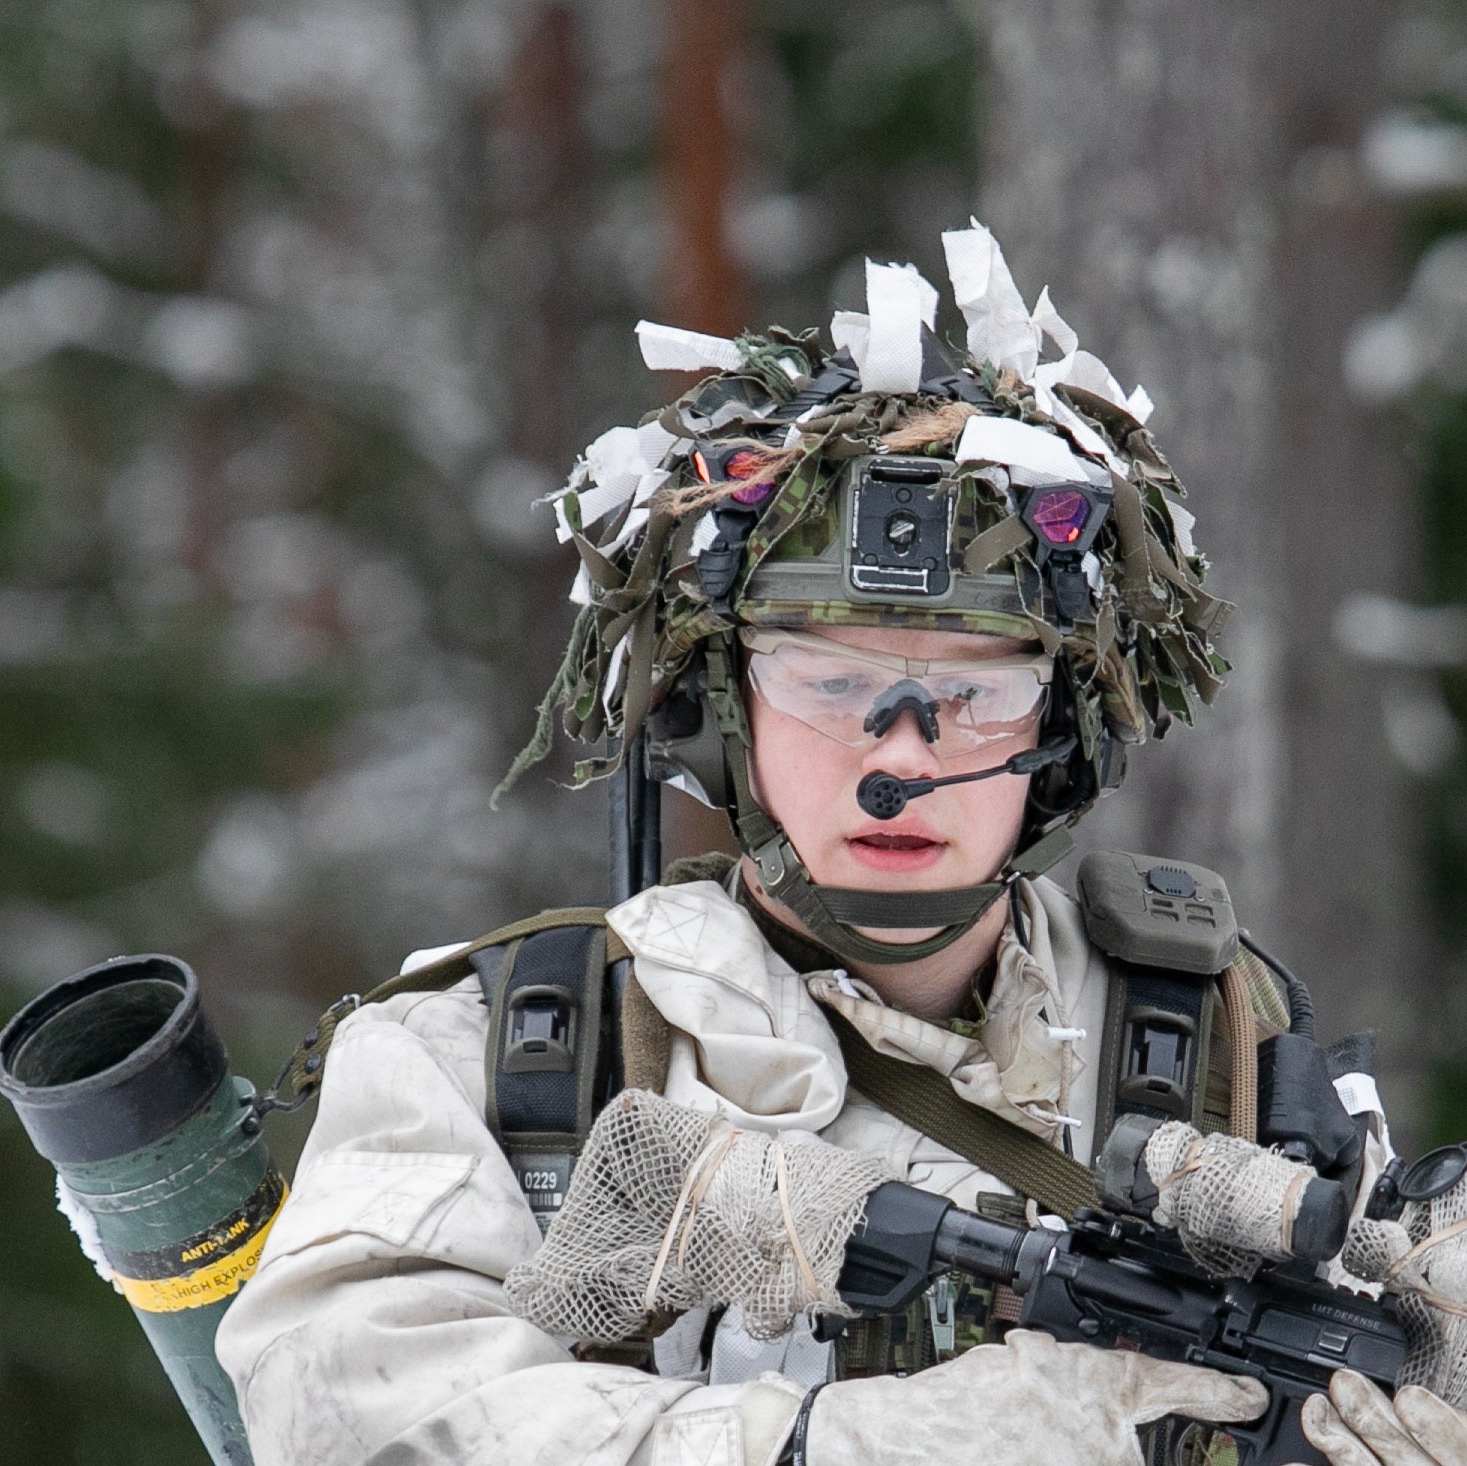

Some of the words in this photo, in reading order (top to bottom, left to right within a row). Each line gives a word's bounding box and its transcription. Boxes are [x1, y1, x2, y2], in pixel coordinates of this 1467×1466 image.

[524, 1171, 557, 1189] 0229
[177, 1279, 212, 1298] HIGH
[1311, 1303, 1333, 1315] LMT
[1333, 1309, 1381, 1330] DEFENSE
